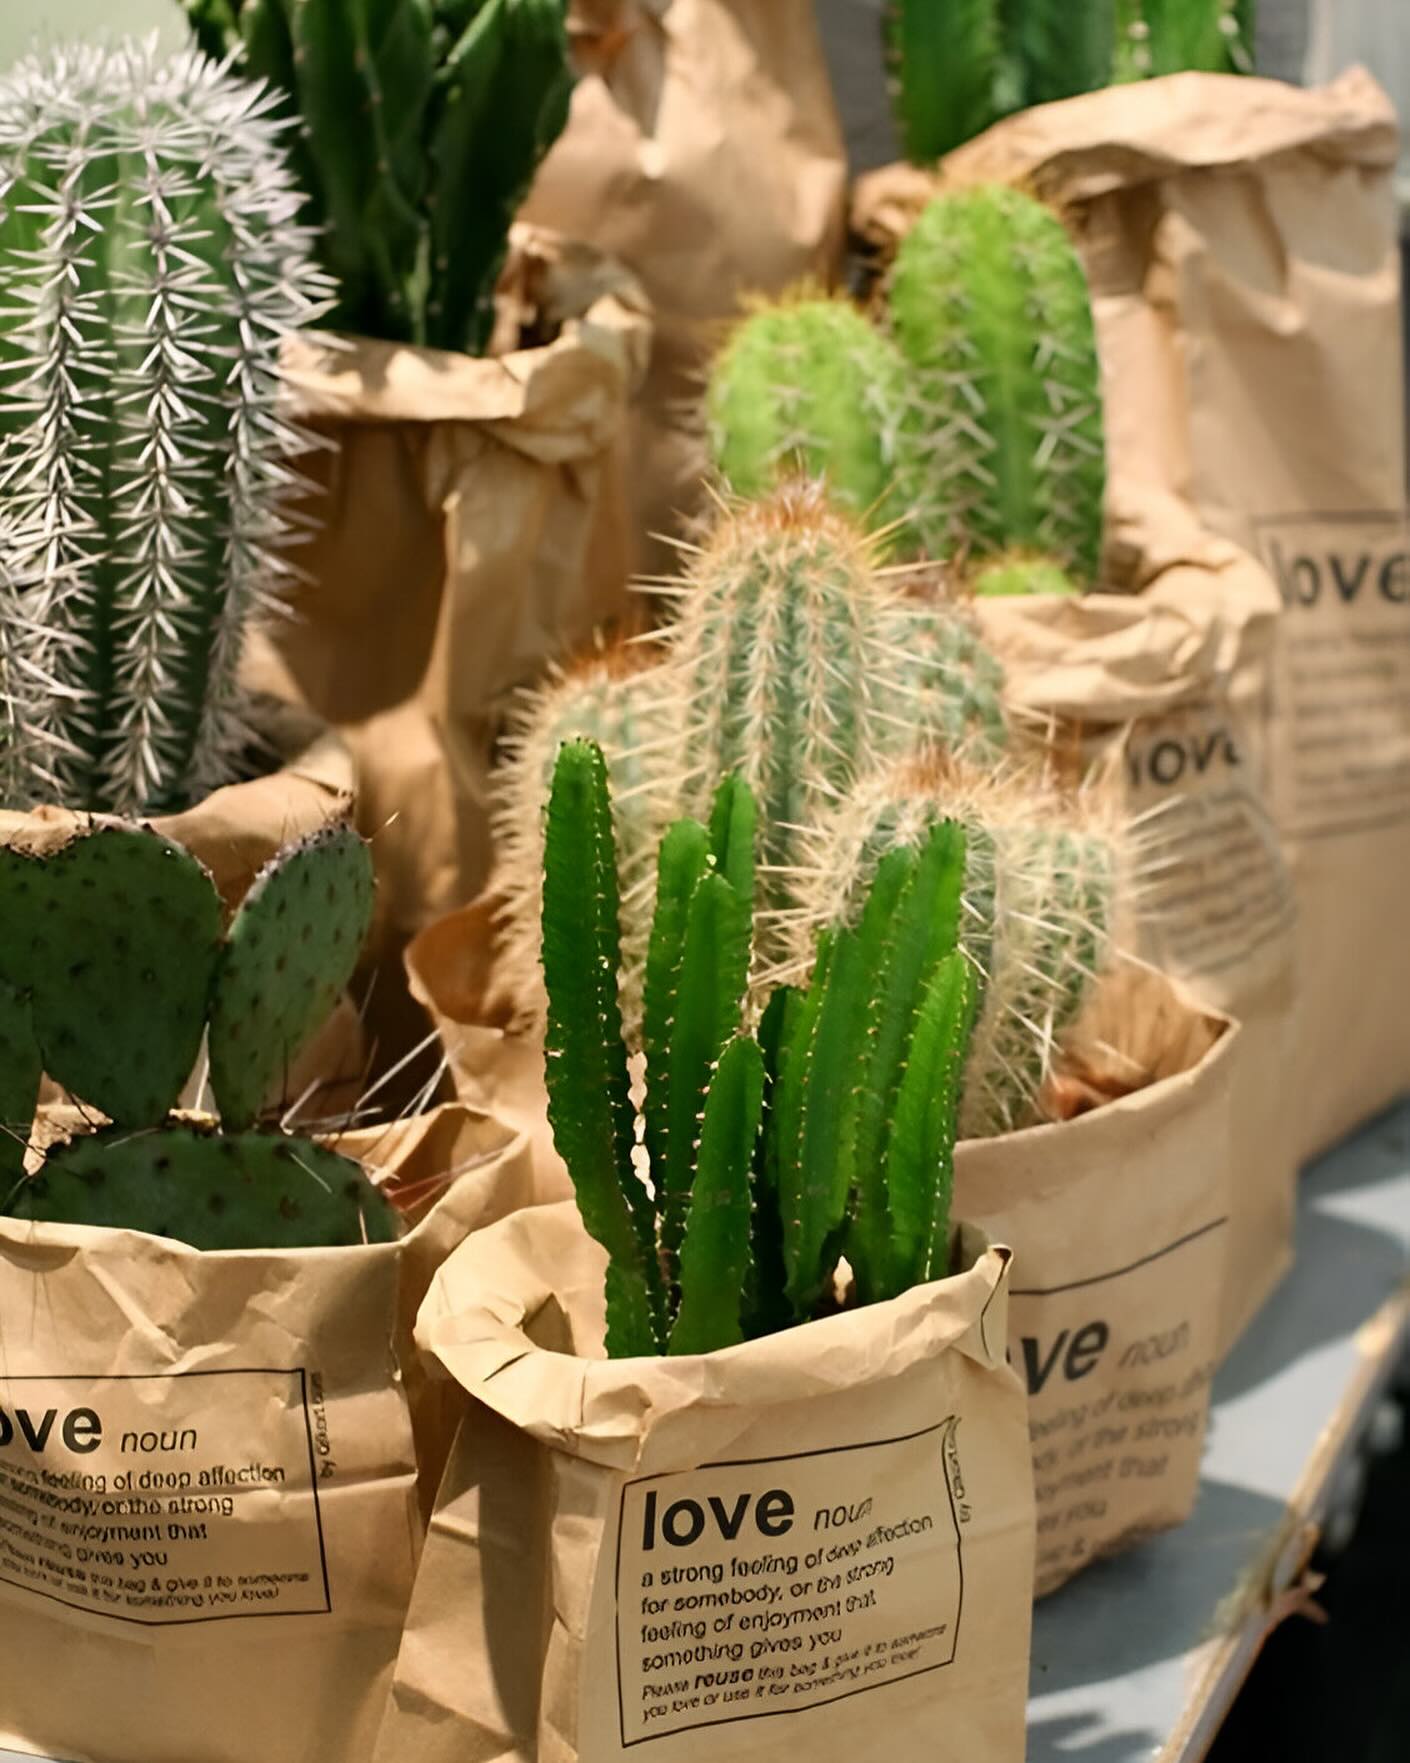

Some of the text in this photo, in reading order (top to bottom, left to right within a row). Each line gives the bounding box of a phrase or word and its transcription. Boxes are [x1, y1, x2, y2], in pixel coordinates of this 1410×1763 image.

[1006, 1319, 1109, 1395] ve
[120, 1429, 198, 1452] noun
[642, 1489, 795, 1551] love
[129, 1551, 169, 1571] you
[660, 1562, 724, 1585] strong
[641, 1596, 669, 1615] for
[789, 1581, 813, 1598] or
